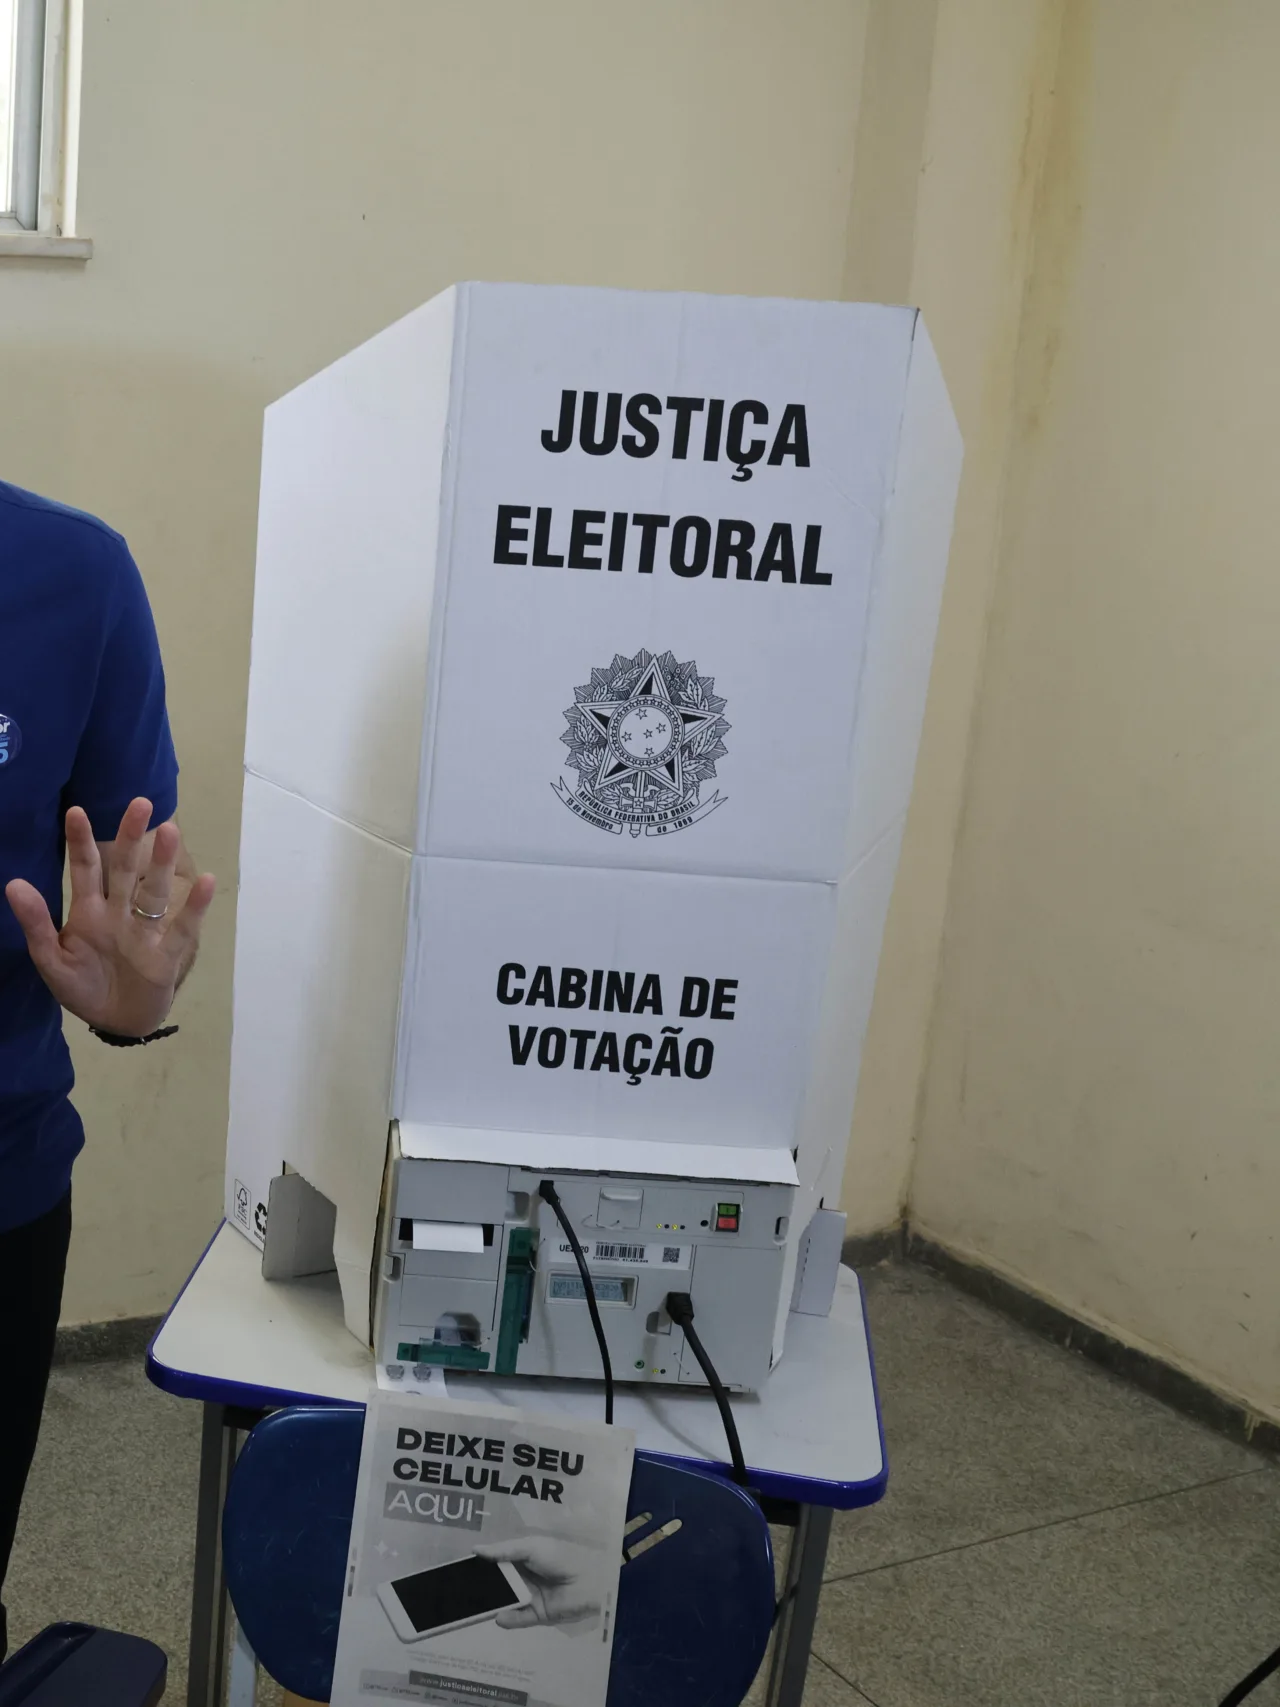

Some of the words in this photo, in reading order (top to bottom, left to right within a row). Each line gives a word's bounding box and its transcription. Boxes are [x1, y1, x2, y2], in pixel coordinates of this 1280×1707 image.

[541, 389, 811, 482] JUSTIÇA
[493, 504, 833, 585] ELEITORAL
[614, 811, 656, 823] FEDERATIVA
[658, 813, 669, 821] DO
[671, 800, 696, 818] BRASIL
[496, 963, 663, 1016] CABINA
[679, 976, 738, 1020] DE
[508, 1024, 715, 1086] VOTAÇÃO
[559, 1244, 589, 1254] UE220
[396, 1427, 505, 1463] DEIXE
[512, 1443, 584, 1476] SEU
[393, 1457, 564, 1504] CELULAR
